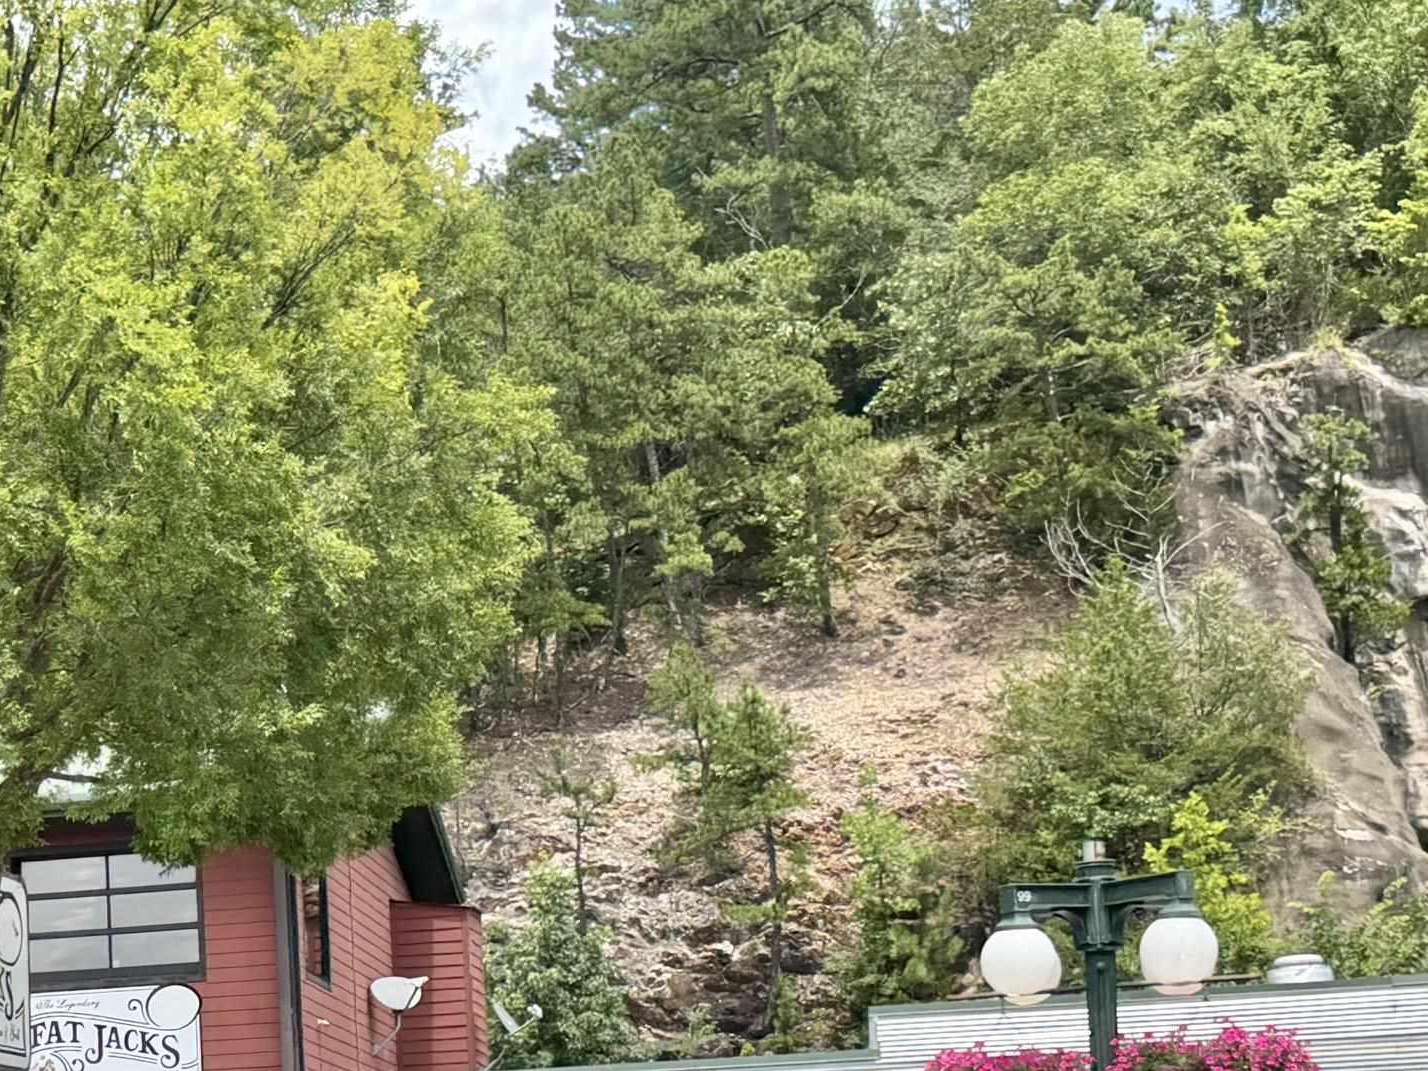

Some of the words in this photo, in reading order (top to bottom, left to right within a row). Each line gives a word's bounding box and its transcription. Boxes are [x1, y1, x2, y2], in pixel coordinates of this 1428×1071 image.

[1017, 890, 1032, 902] 99
[30, 1020, 85, 1049] FAT
[85, 1023, 181, 1069] JACKS
